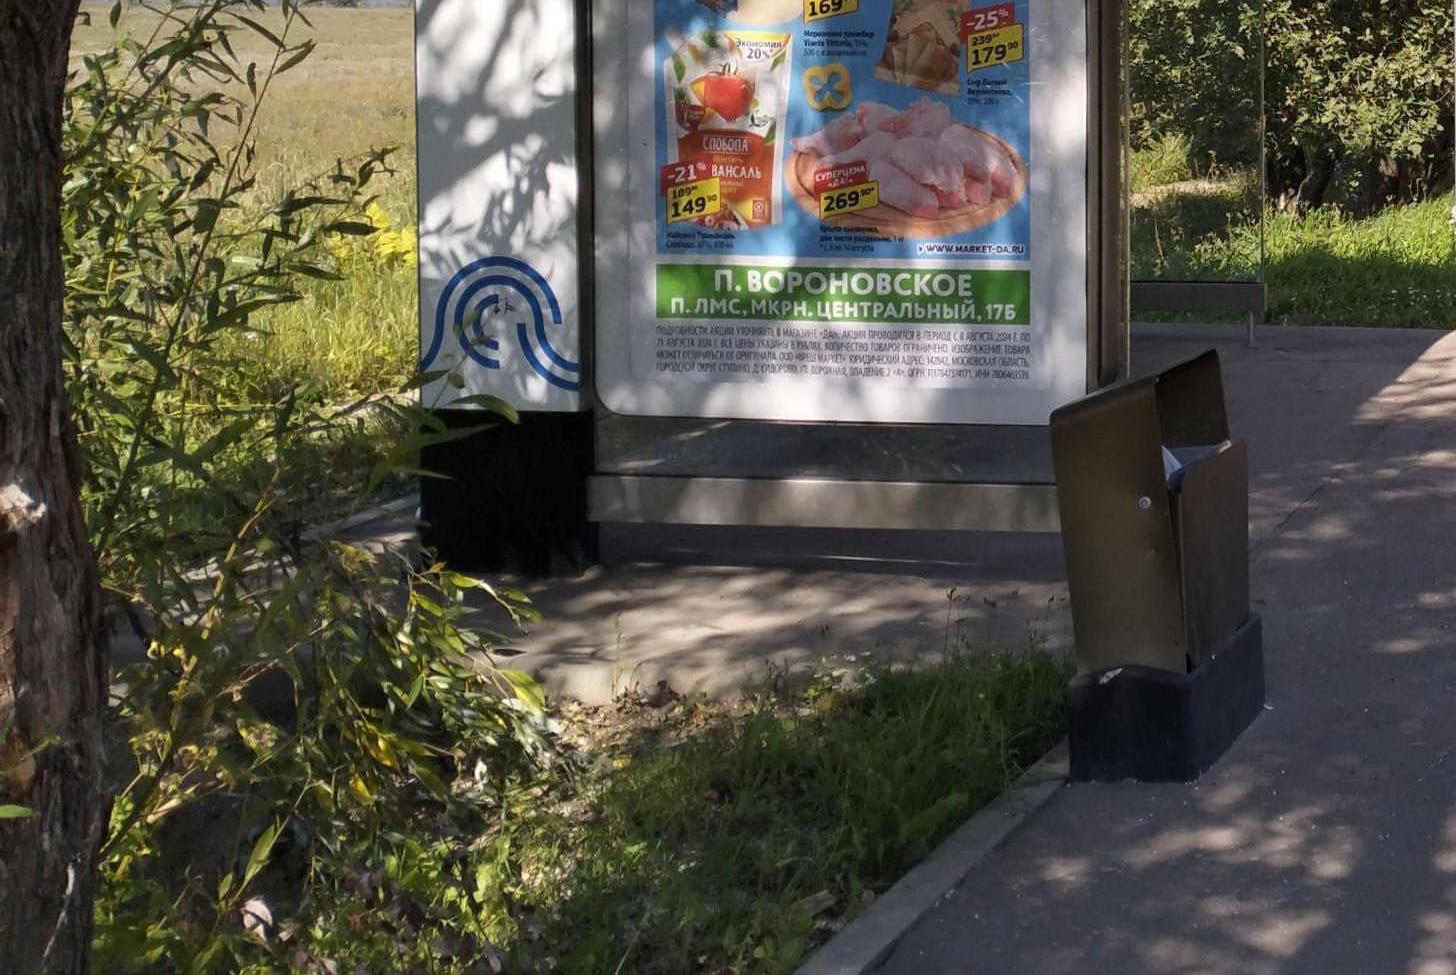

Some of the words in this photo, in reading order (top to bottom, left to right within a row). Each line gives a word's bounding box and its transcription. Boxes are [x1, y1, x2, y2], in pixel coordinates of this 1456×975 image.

[966, 9, 1009, 31] -25%
[736, 37, 782, 48] Экономия
[667, 161, 707, 183] -21%
[815, 165, 866, 182] СУПЕРЦЕНА
[925, 244, 1025, 255] WWW.MARKET-DA.RU
[714, 269, 742, 292] П.
[747, 270, 973, 296] ВОРОНОВСКОЕ
[671, 297, 691, 314] П.
[694, 298, 747, 316] ЛМС,
[751, 299, 813, 317] МКРН.
[817, 299, 982, 322] ЦЕНТРАЛЬНЫЙ,
[985, 303, 1016, 320] 17Б
